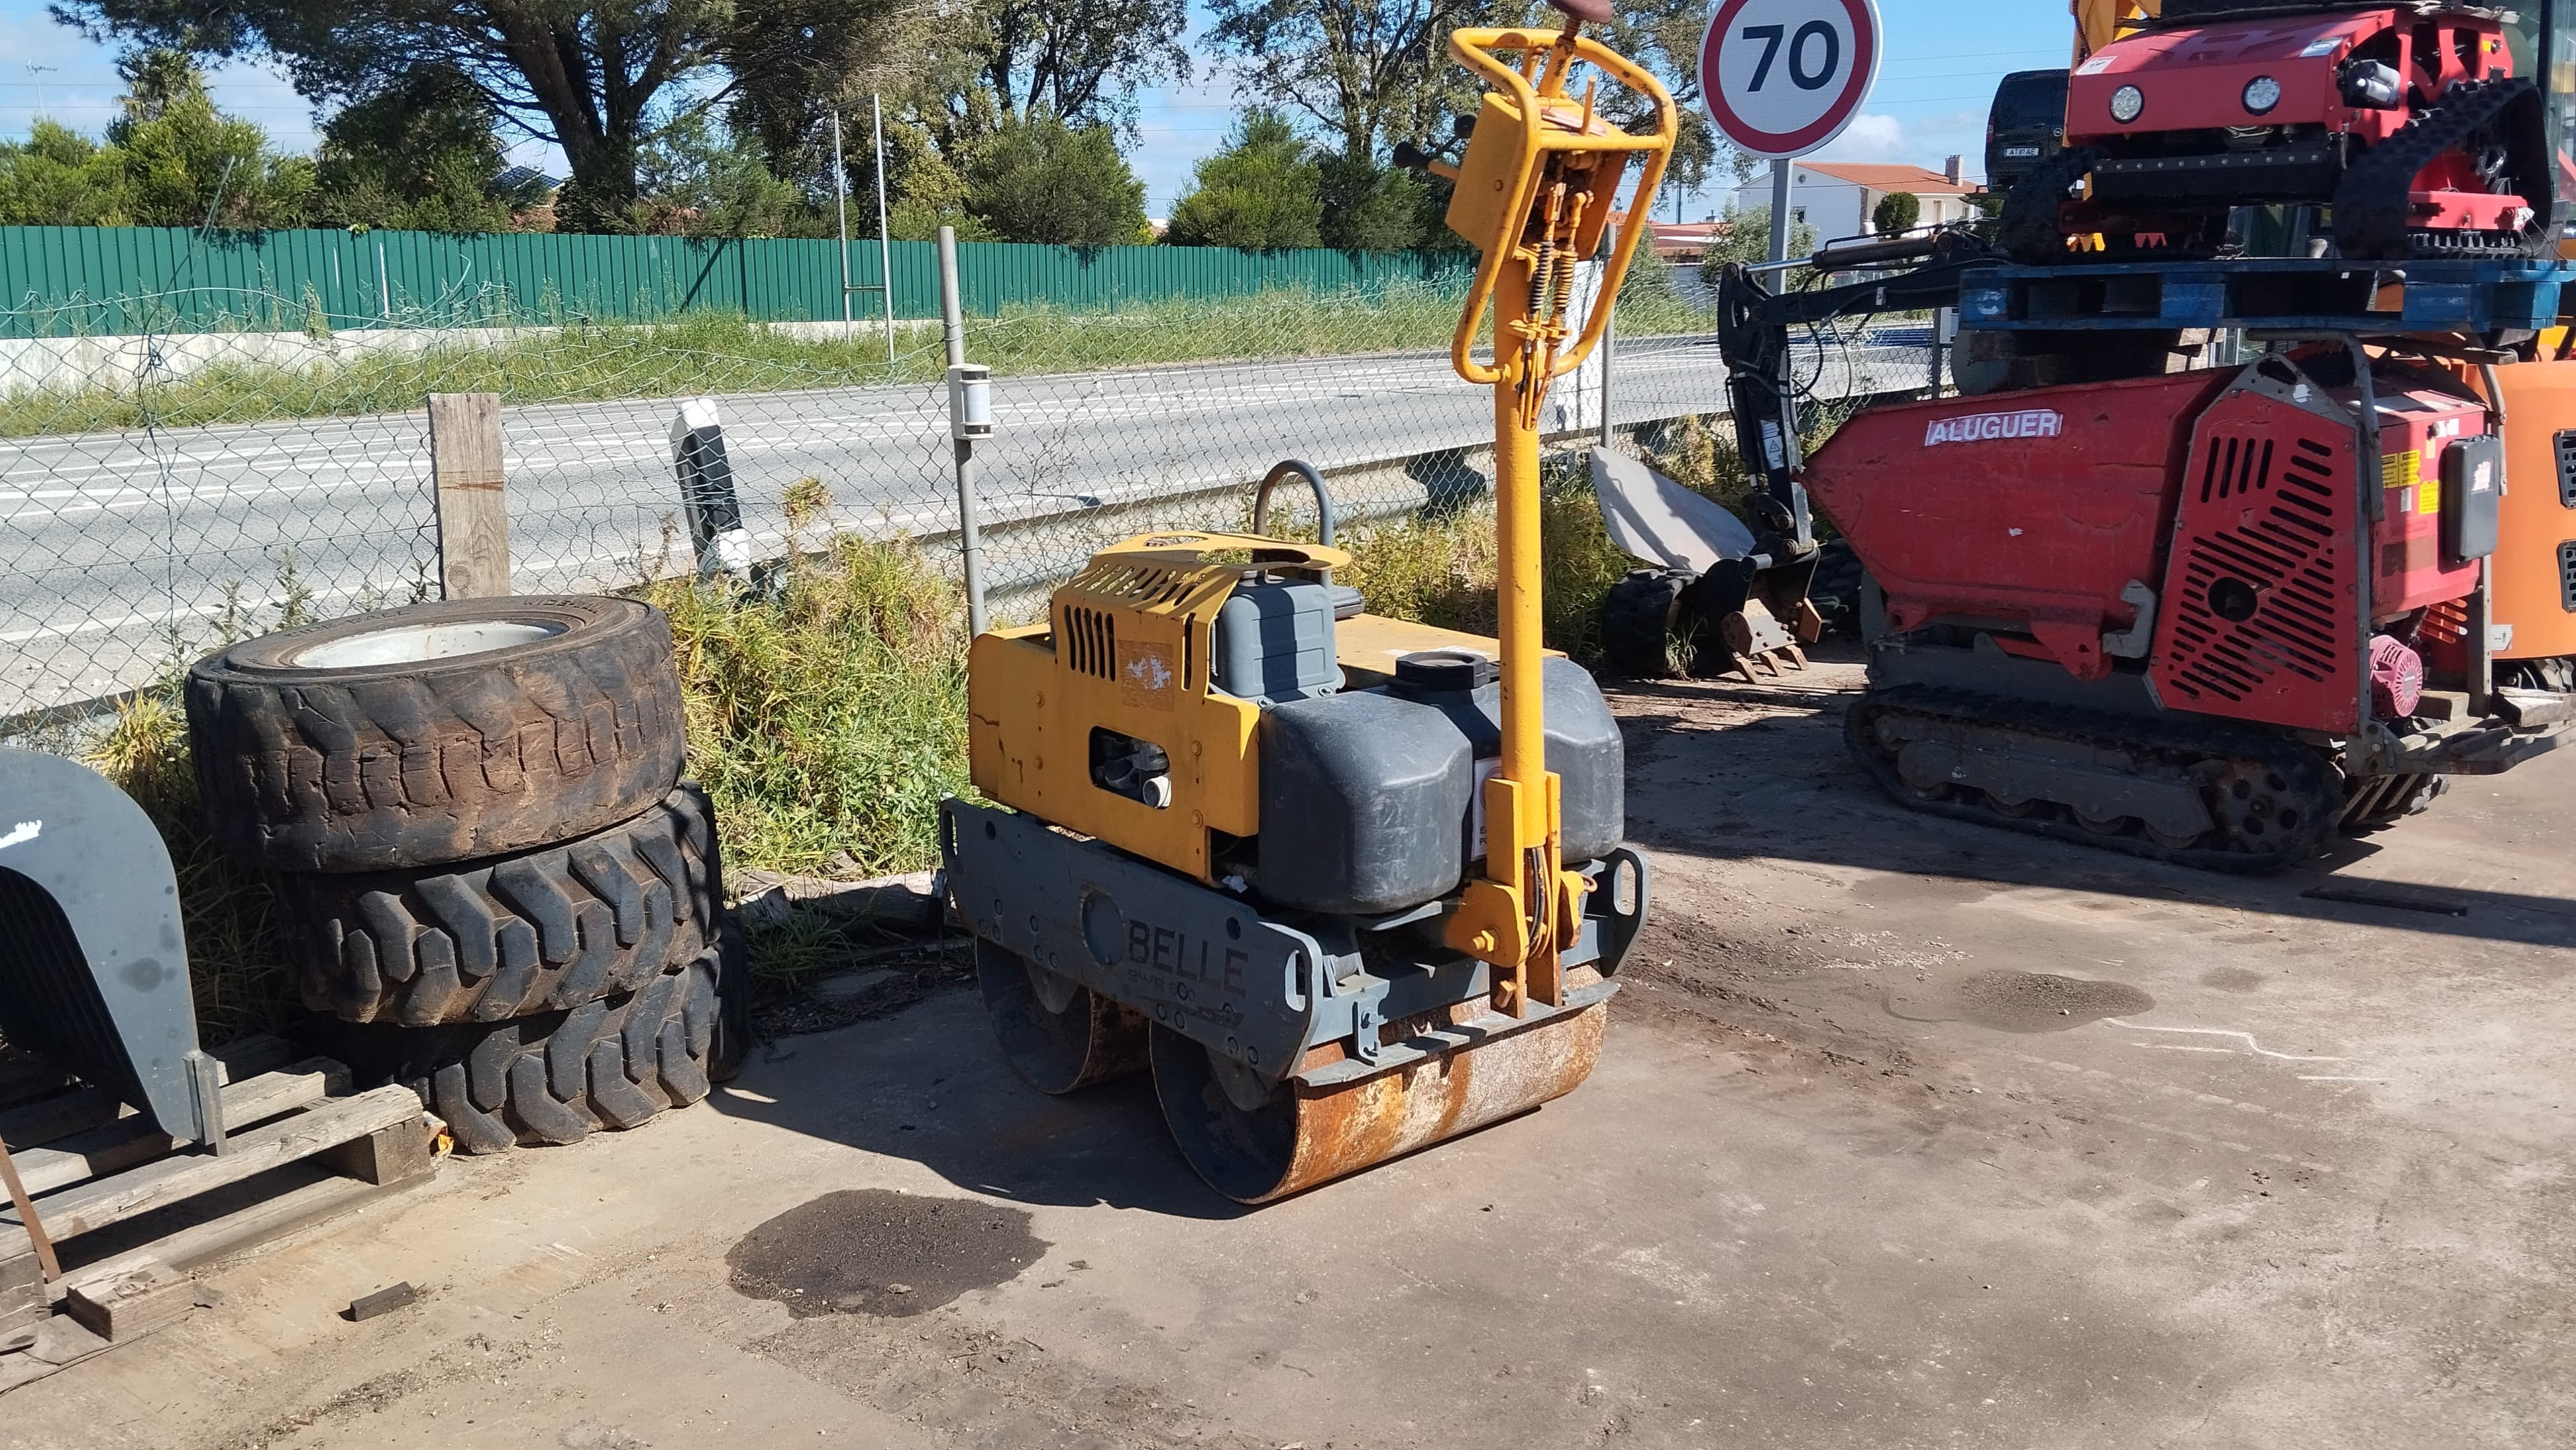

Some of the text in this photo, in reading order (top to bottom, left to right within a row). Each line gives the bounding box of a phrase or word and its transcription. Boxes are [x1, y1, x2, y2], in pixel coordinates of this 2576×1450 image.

[1742, 19, 1839, 93] 70
[1929, 413, 2057, 444] ALUGUER
[1128, 919, 1248, 998] BELLE
